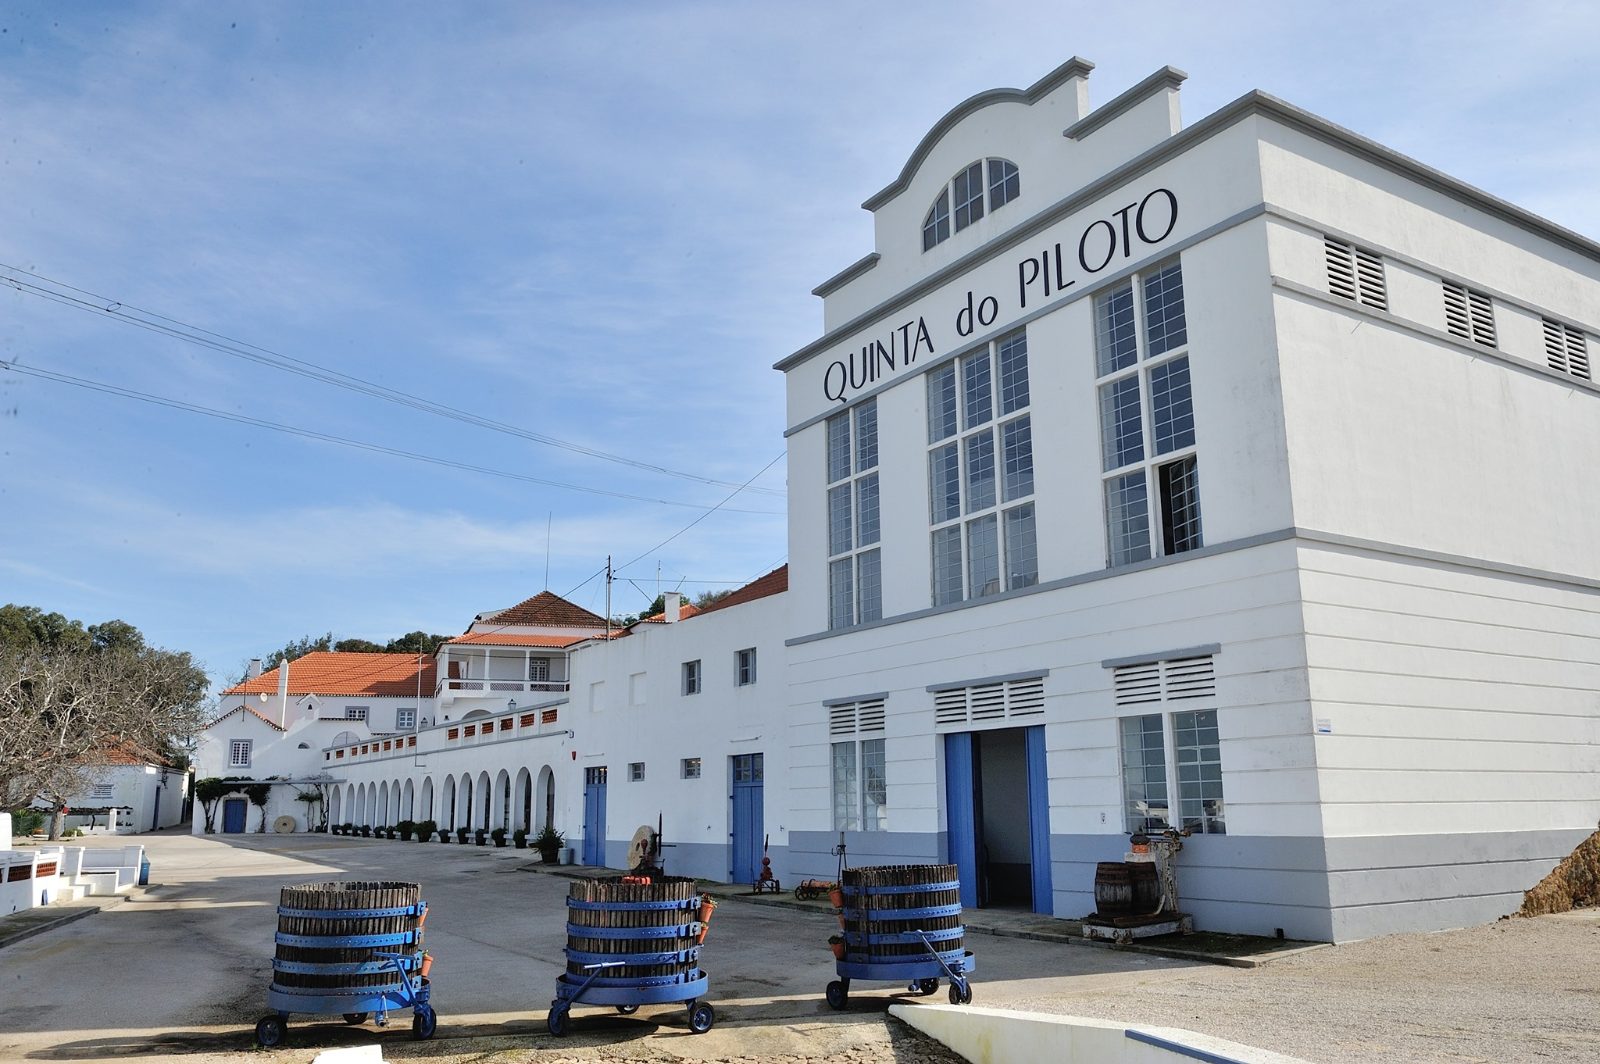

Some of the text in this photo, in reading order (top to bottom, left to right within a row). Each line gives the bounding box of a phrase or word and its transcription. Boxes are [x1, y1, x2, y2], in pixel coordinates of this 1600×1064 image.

[823, 188, 1178, 403] QUINTA do PILOTO
